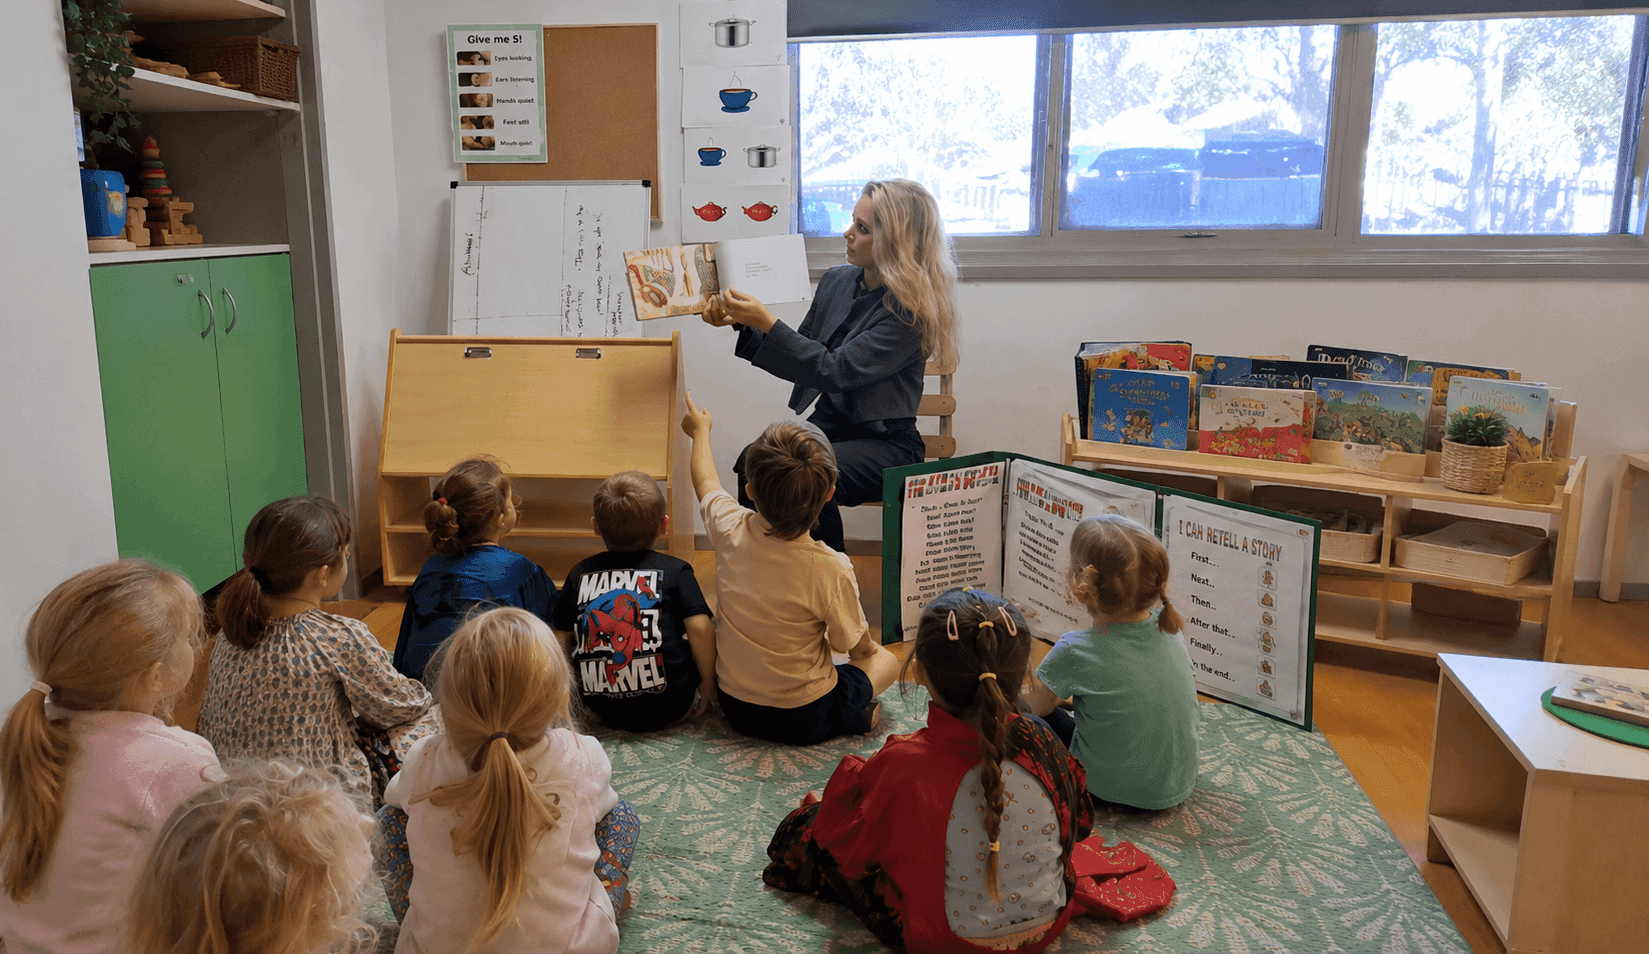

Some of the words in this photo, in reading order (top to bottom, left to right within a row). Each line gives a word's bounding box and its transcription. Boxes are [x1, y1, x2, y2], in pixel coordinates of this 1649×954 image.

[467, 34, 491, 44] Give
[493, 36, 510, 44] me
[1206, 526, 1239, 550] RETELL
[1241, 536, 1249, 553] A
[1251, 538, 1282, 562] STORY
[1190, 616, 1210, 630] After
[580, 656, 665, 693] MARVEL
[1200, 663, 1213, 674] the
